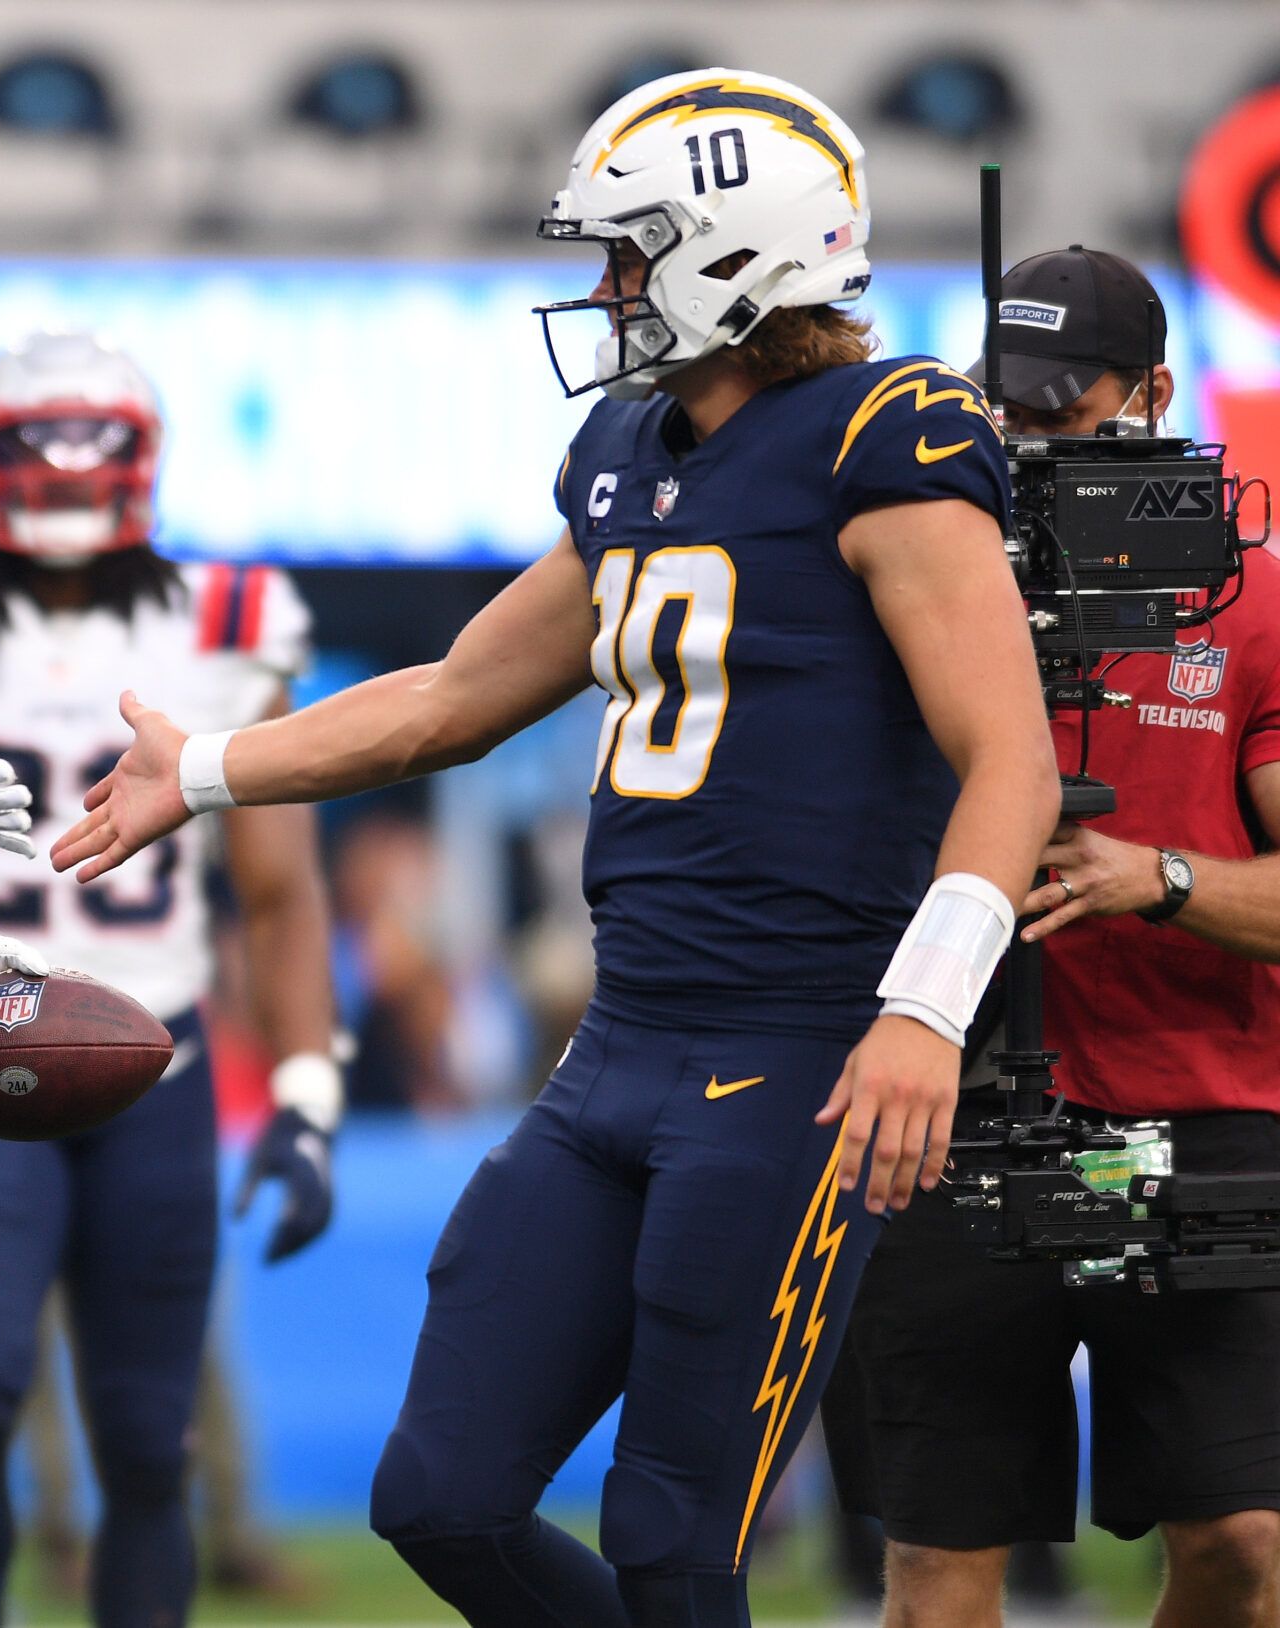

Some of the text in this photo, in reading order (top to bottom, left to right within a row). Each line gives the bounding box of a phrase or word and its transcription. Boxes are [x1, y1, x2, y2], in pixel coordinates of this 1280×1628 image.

[684, 128, 748, 196] 10
[1015, 308, 1056, 322] SPORTS
[587, 472, 618, 518] C
[1076, 486, 1119, 497] SONY
[1125, 476, 1216, 522] AVS
[589, 544, 738, 801] 10
[1175, 664, 1216, 694] NFL
[7, 1081, 29, 1094] 244
[1052, 1191, 1091, 1201] PRO
